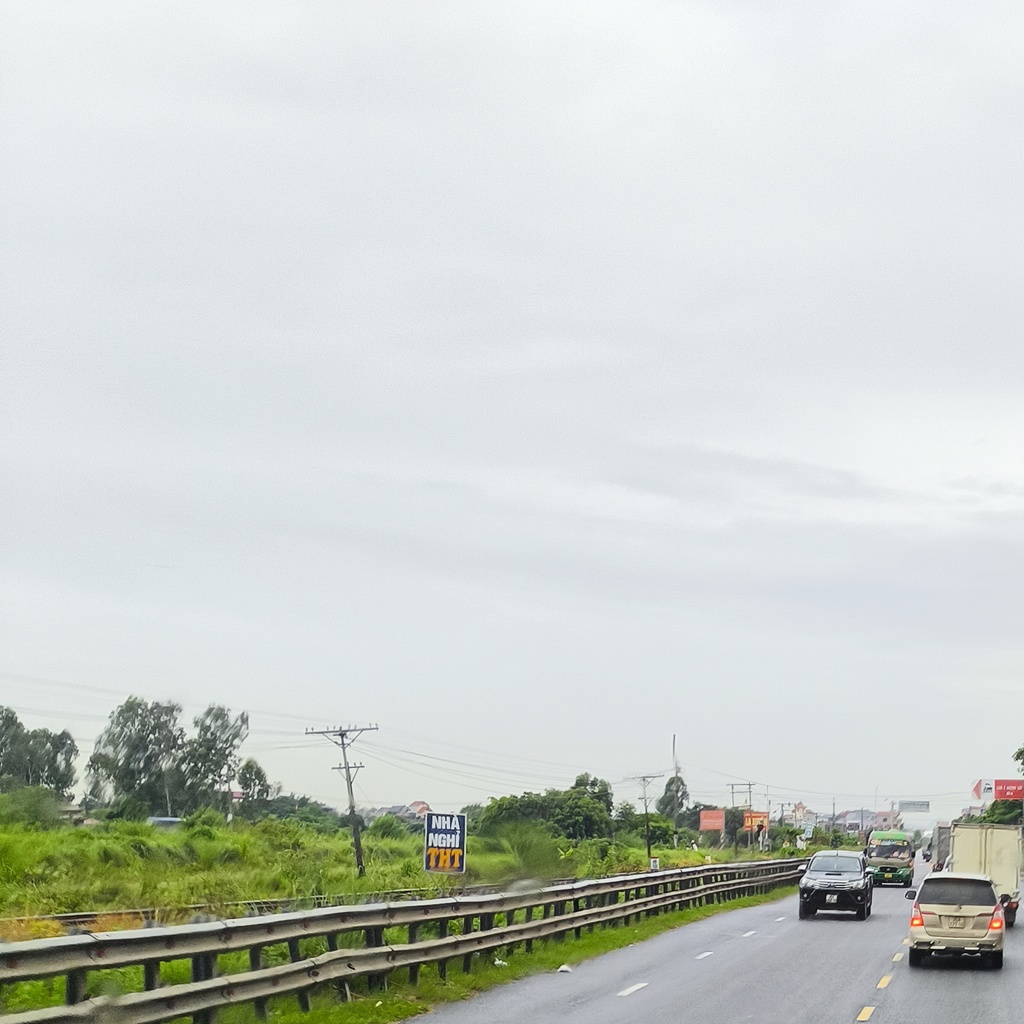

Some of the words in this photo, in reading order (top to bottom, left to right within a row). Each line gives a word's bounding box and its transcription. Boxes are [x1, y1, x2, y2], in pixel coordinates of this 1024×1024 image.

[431, 811, 460, 830] NHÀ
[428, 830, 460, 848] NGHỈ
[427, 848, 463, 868] THT
